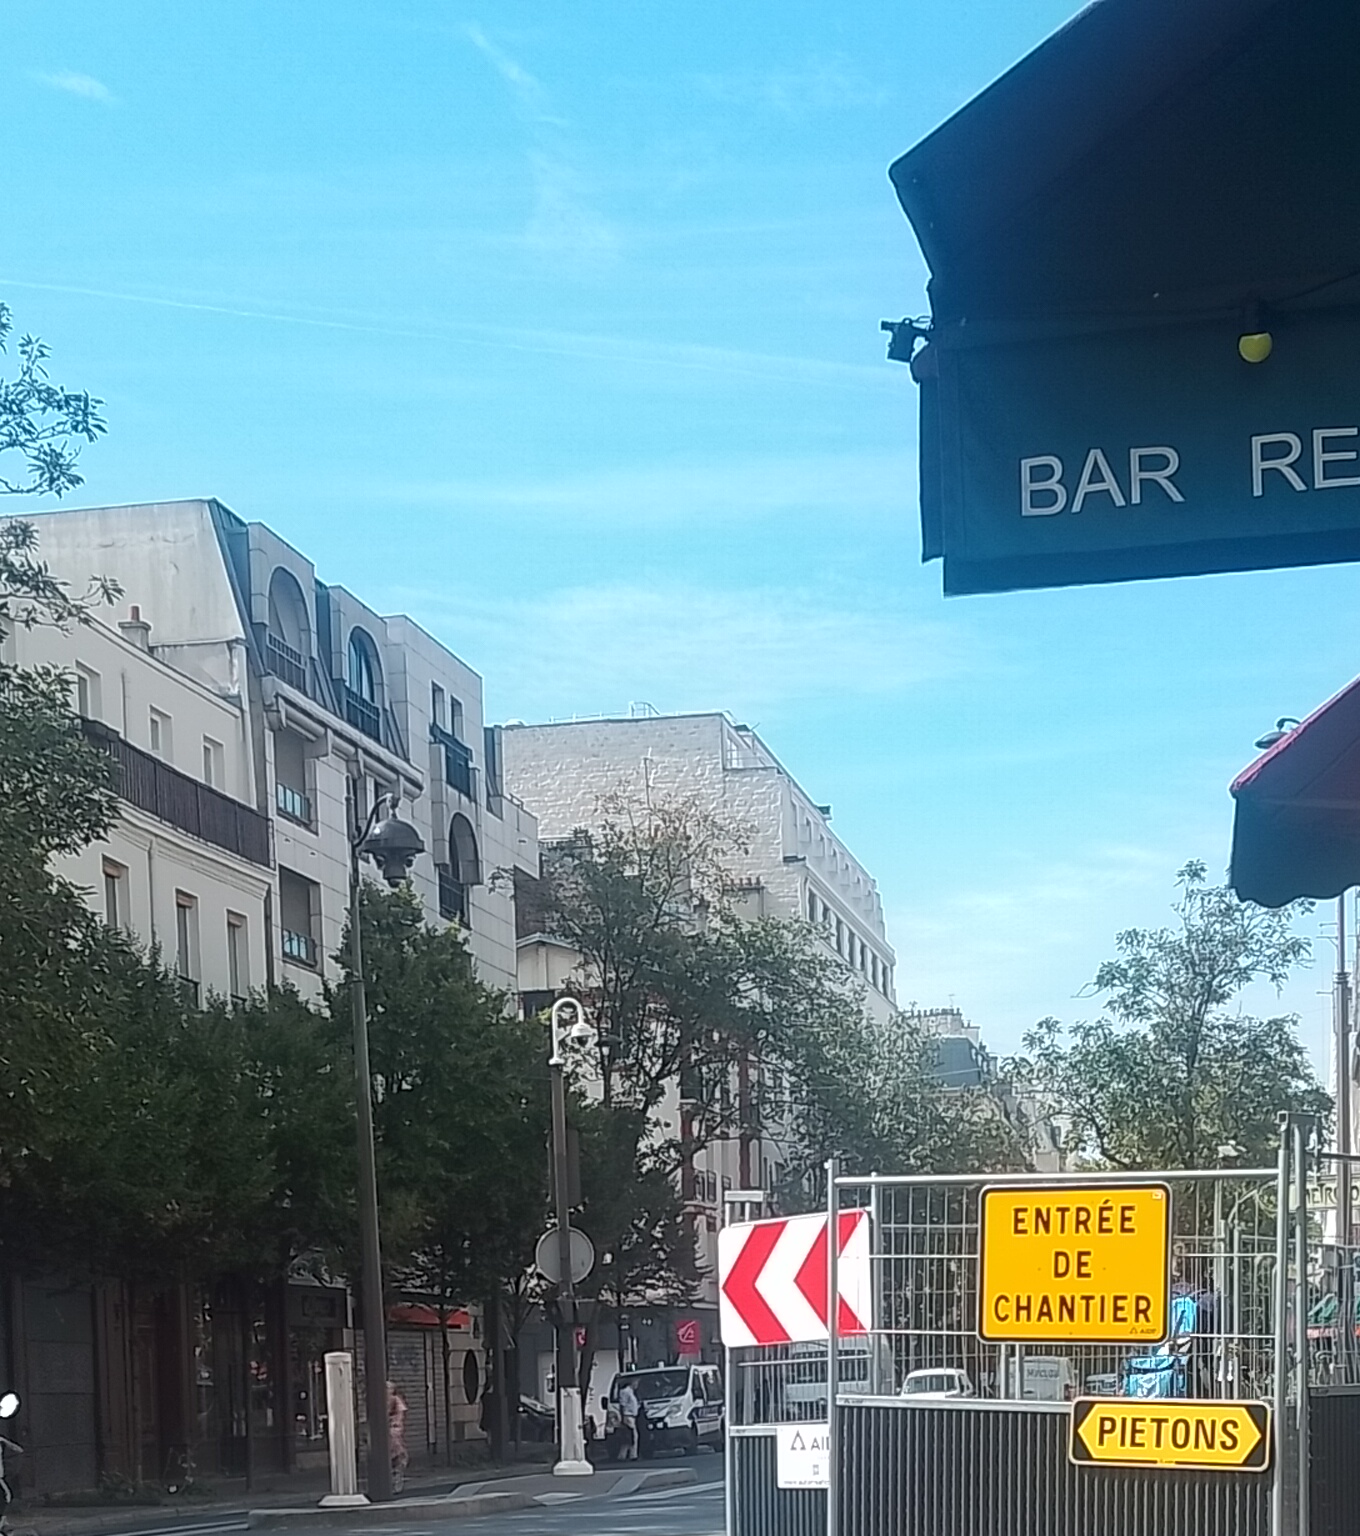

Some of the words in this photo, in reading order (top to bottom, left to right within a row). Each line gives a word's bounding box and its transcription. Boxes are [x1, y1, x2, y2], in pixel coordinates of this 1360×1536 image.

[1018, 444, 1185, 516] BAR
[1012, 1198, 1138, 1236] ENTRÉE
[1051, 1250, 1093, 1279] DE
[993, 1294, 1153, 1324] CHANTIER
[1097, 1415, 1241, 1453] PIETONS
